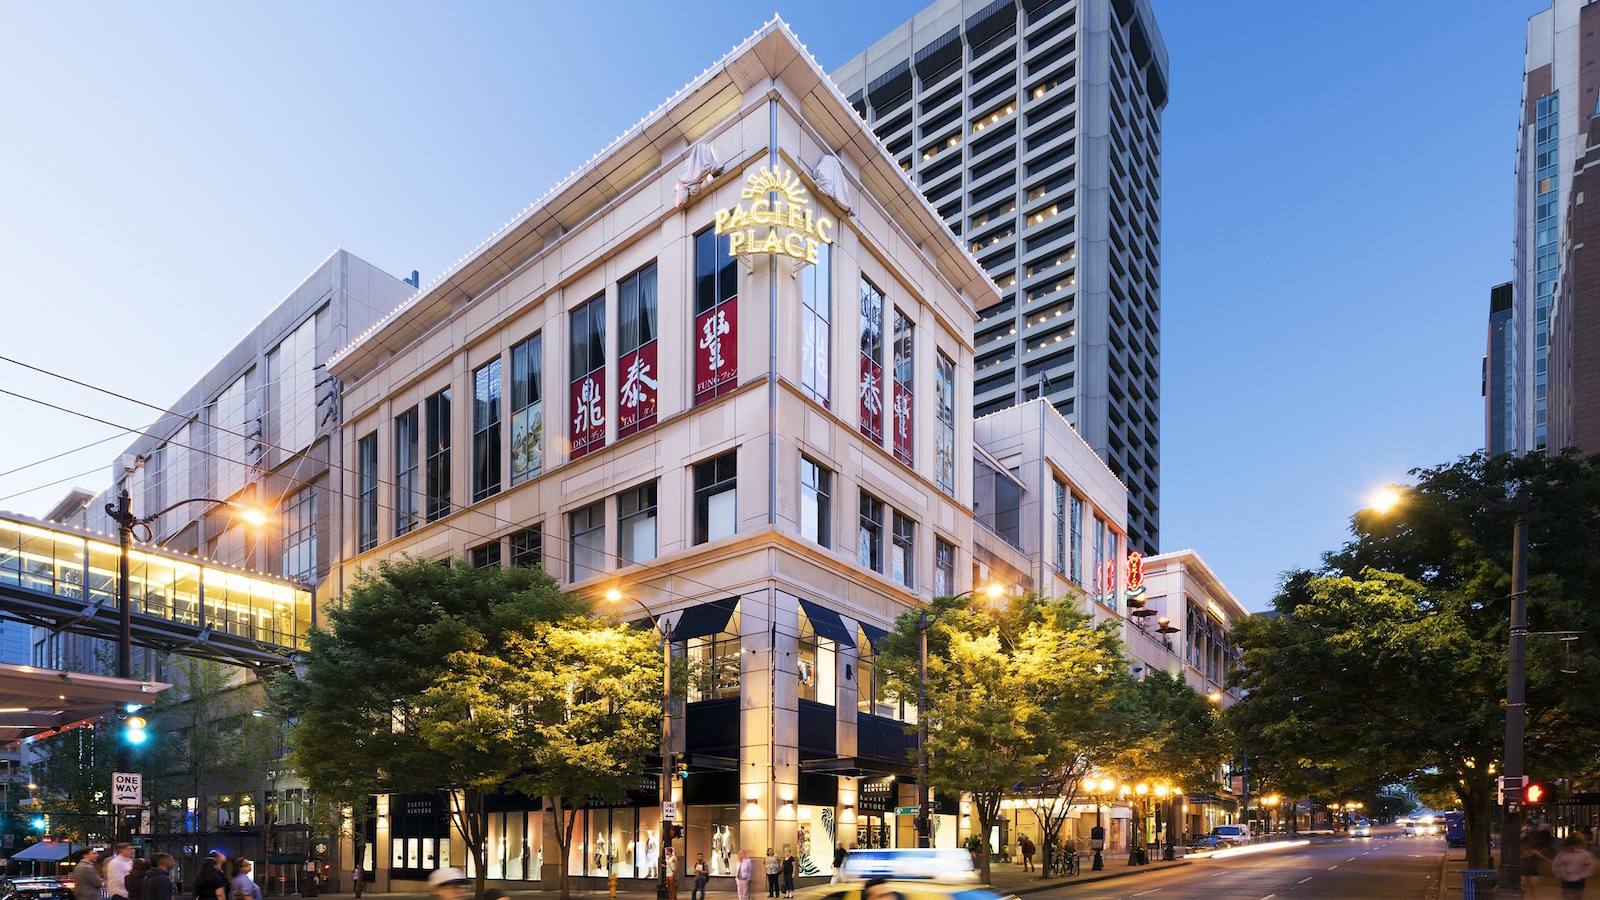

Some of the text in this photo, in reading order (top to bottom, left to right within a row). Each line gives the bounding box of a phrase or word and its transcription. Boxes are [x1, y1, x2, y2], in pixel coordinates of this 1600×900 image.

[714, 199, 833, 244] PACIFIC
[728, 229, 819, 265] PLACE
[619, 355, 658, 408] 泰
[697, 374, 720, 392] FUNG
[623, 413, 636, 426] TAI
[573, 436, 587, 449] DIN
[116, 775, 138, 784] ONE
[116, 784, 138, 792] WAY
